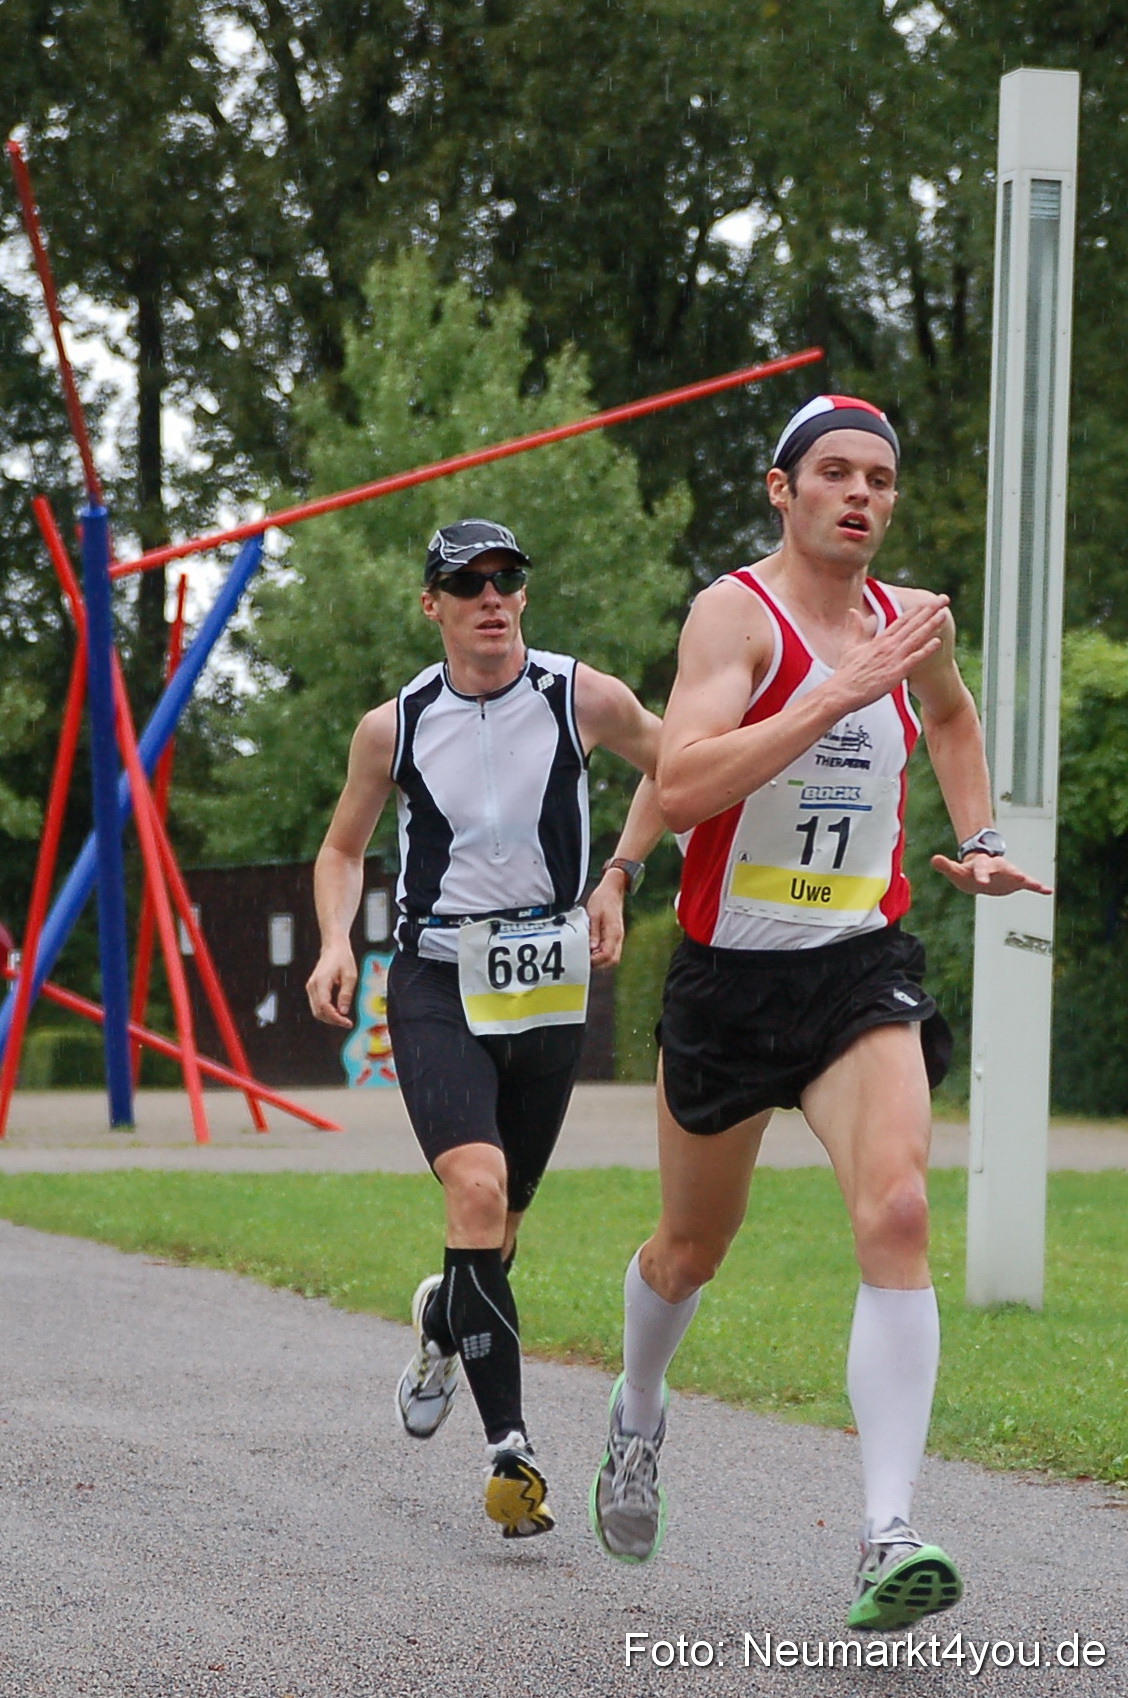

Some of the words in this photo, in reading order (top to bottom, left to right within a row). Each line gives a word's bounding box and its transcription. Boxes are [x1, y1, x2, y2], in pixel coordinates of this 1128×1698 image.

[801, 786, 861, 801] BOCK
[796, 816, 851, 869] 11
[740, 853, 749, 862] A
[790, 878, 831, 903] Uwe
[487, 941, 565, 990] 684
